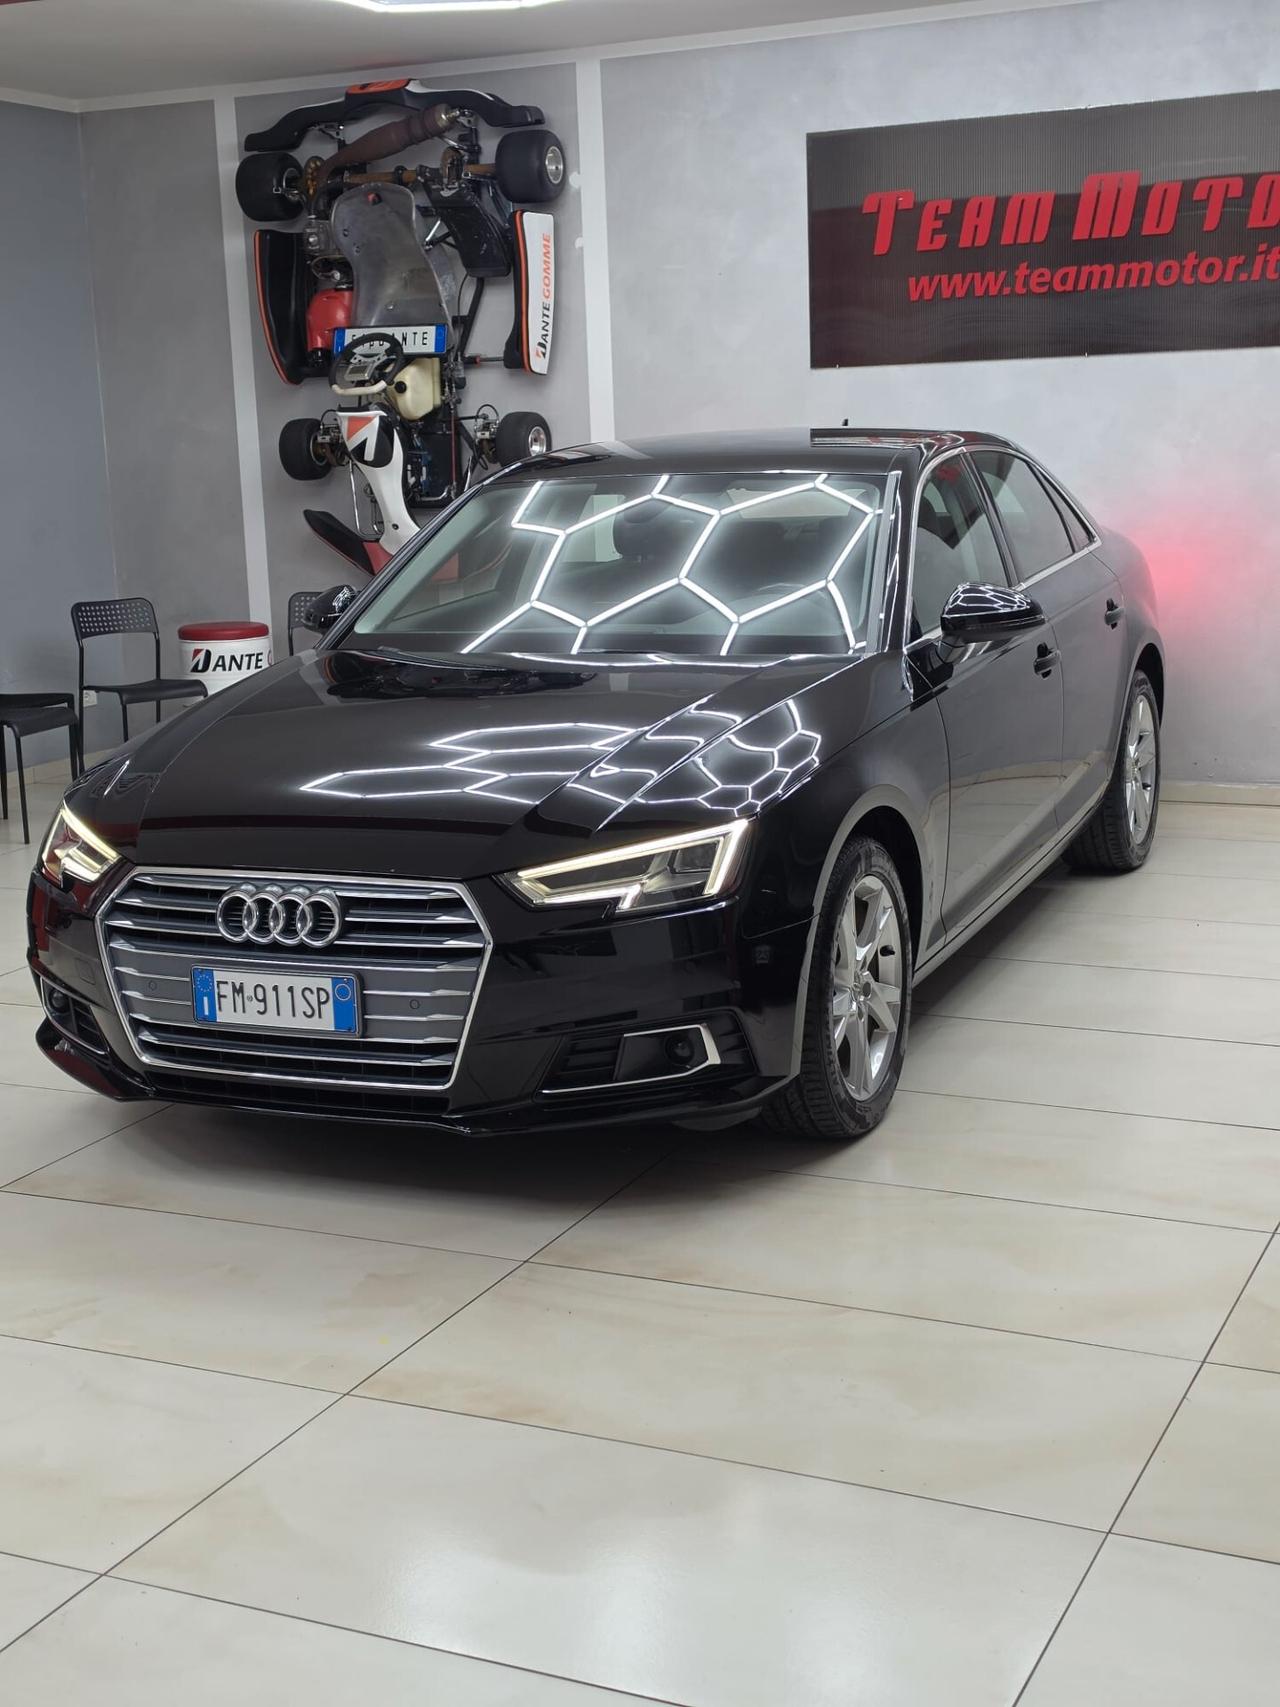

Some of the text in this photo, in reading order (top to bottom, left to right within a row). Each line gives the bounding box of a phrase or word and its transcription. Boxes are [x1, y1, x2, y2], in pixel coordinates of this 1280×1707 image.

[862, 189, 1056, 255] TEAM
[908, 242, 1280, 301] www.teammotor.it
[190, 648, 264, 673] DANTE
